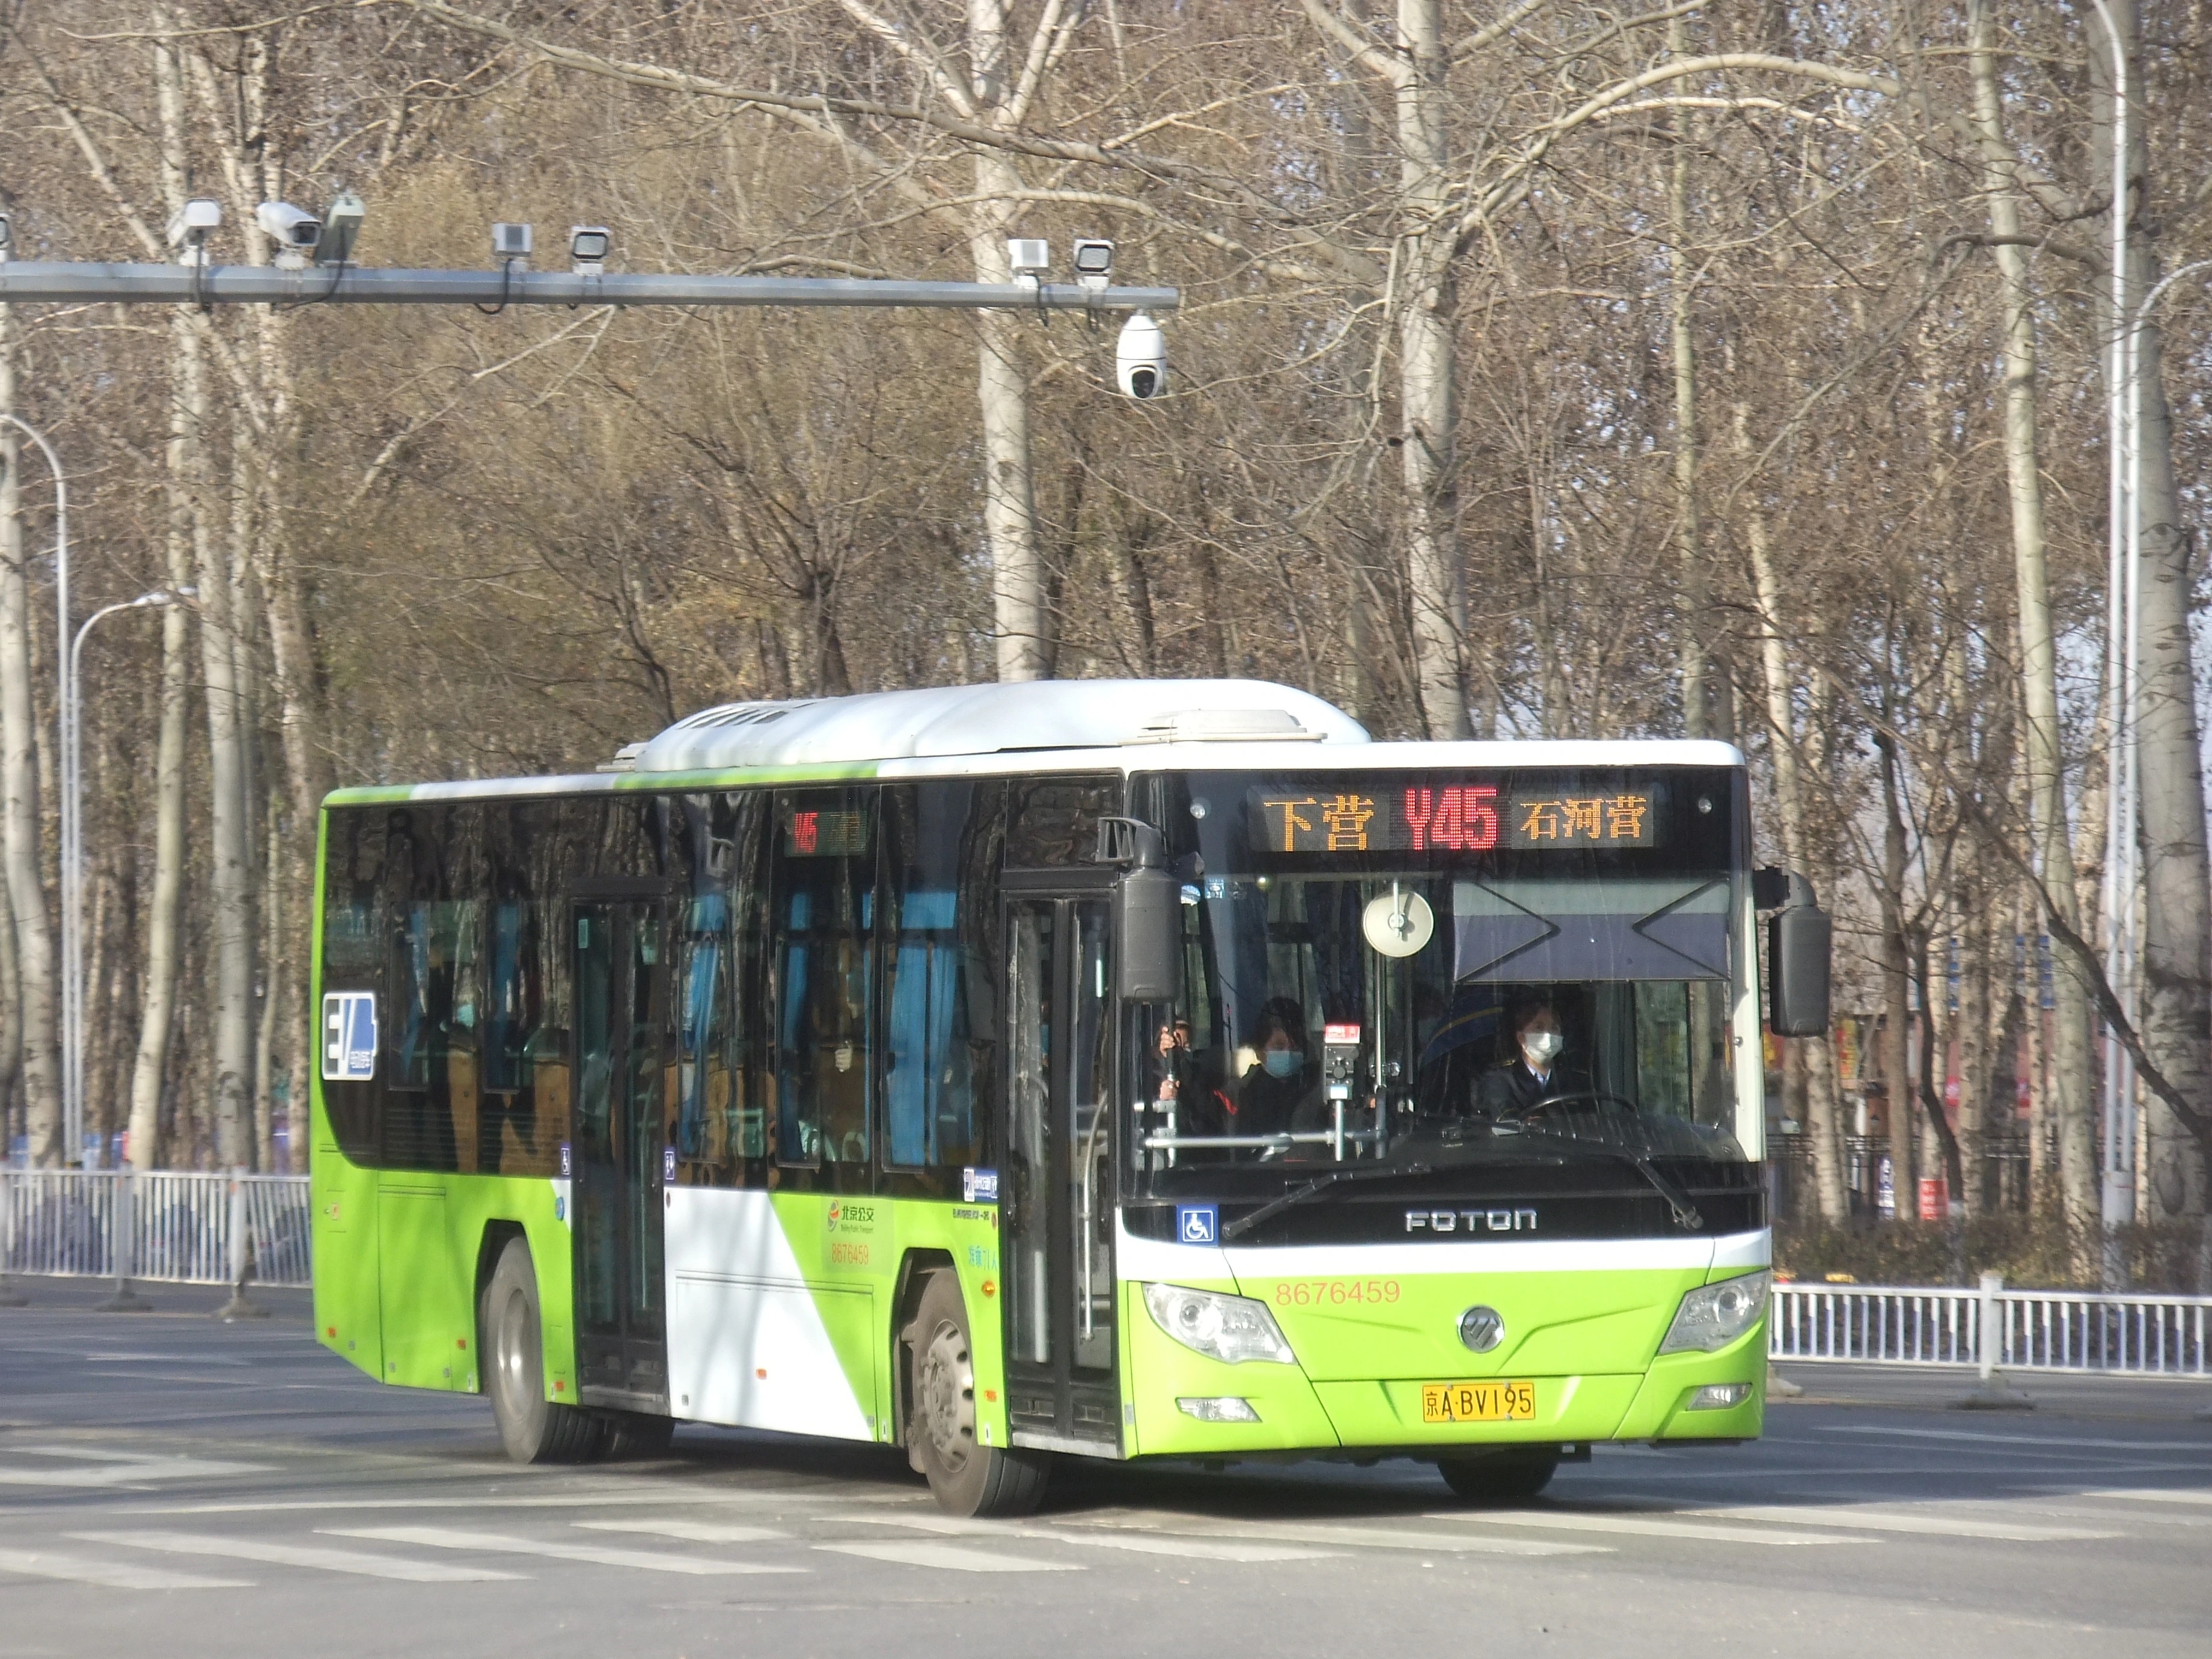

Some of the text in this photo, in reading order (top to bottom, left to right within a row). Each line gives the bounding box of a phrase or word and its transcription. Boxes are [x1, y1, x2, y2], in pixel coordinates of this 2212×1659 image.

[1264, 787, 1646, 851] 下营 Y45 石河营
[842, 1205, 875, 1222] 北京公交
[1405, 1209, 1538, 1232] FOTON
[832, 1243, 869, 1265] 8676459
[1276, 1280, 1401, 1306] 8676459
